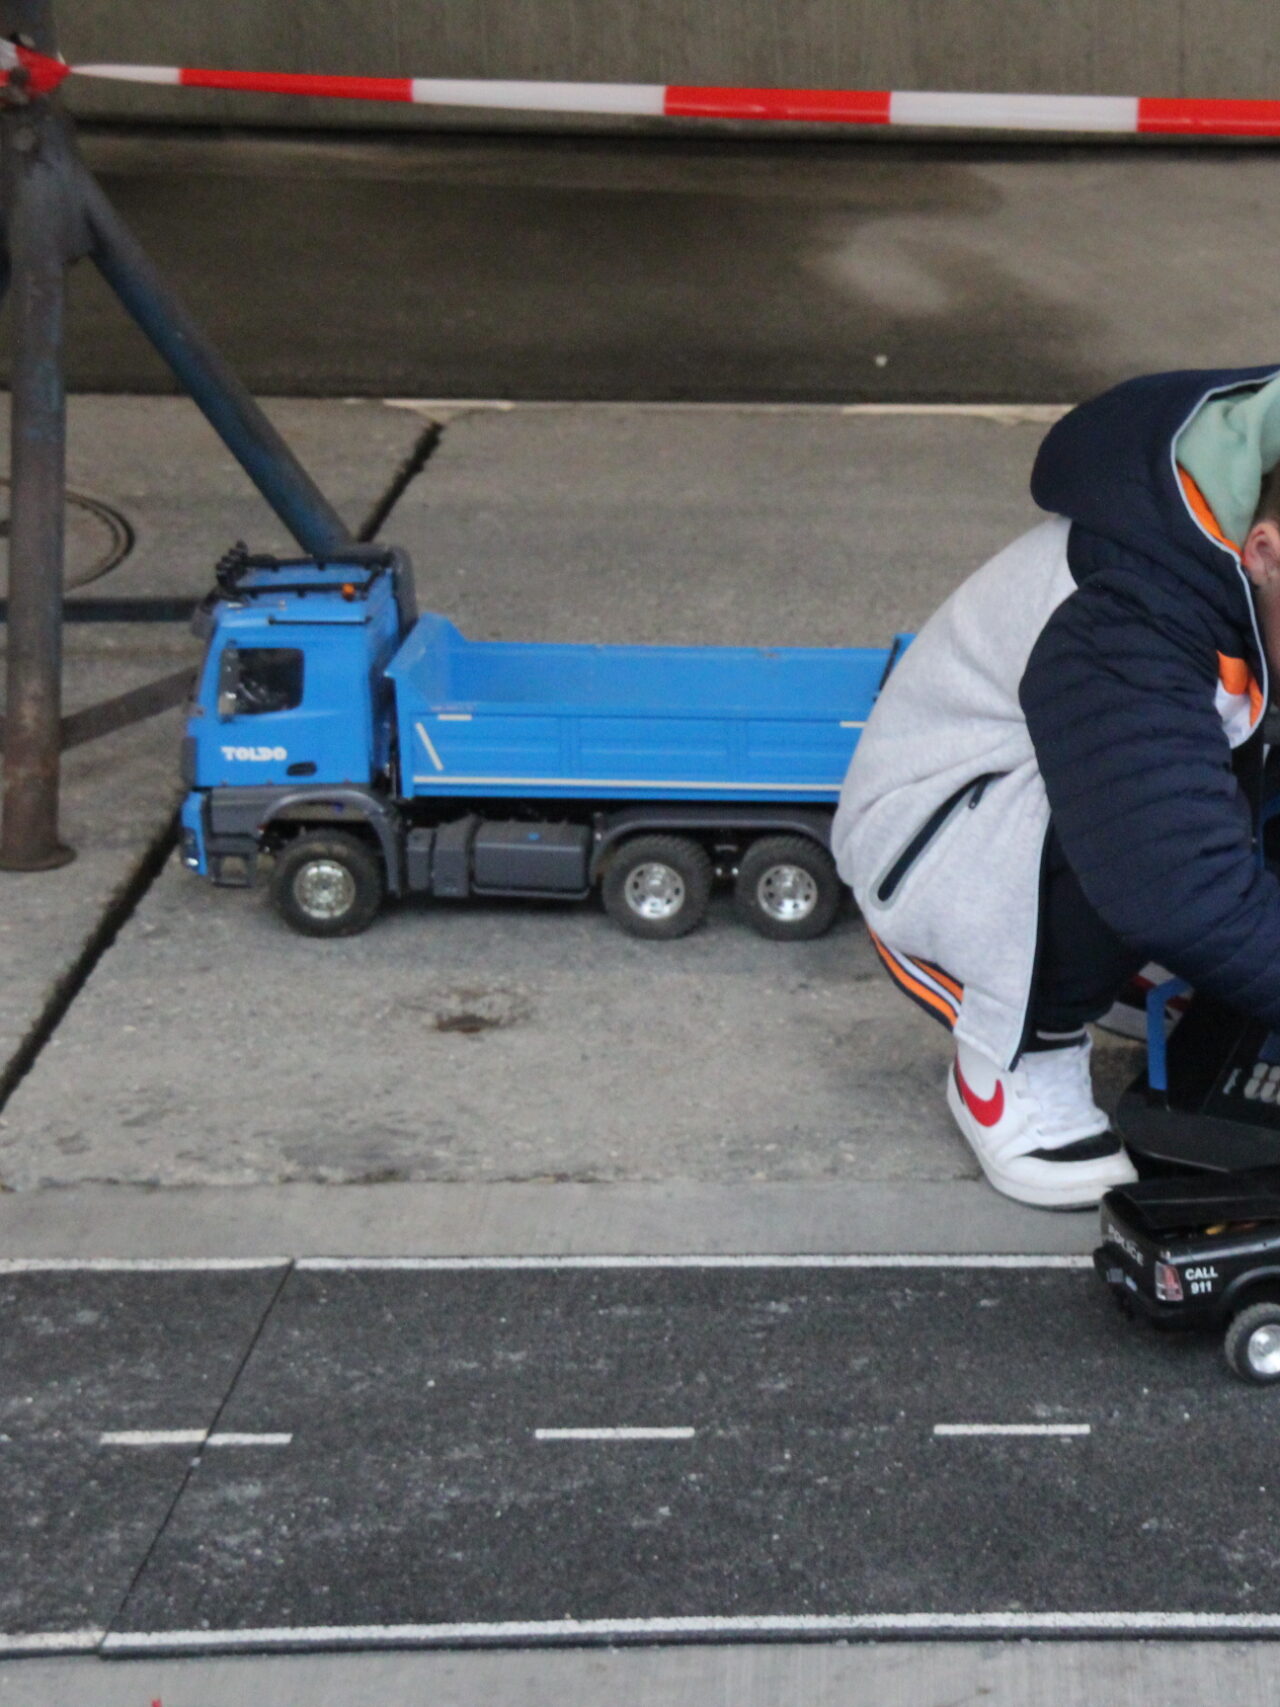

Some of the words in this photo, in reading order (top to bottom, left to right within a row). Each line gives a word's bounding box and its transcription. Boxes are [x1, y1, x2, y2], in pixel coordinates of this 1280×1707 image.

[221, 746, 288, 761] TOLDO
[1185, 1266, 1218, 1281] CALL
[1191, 1281, 1212, 1295] 911
